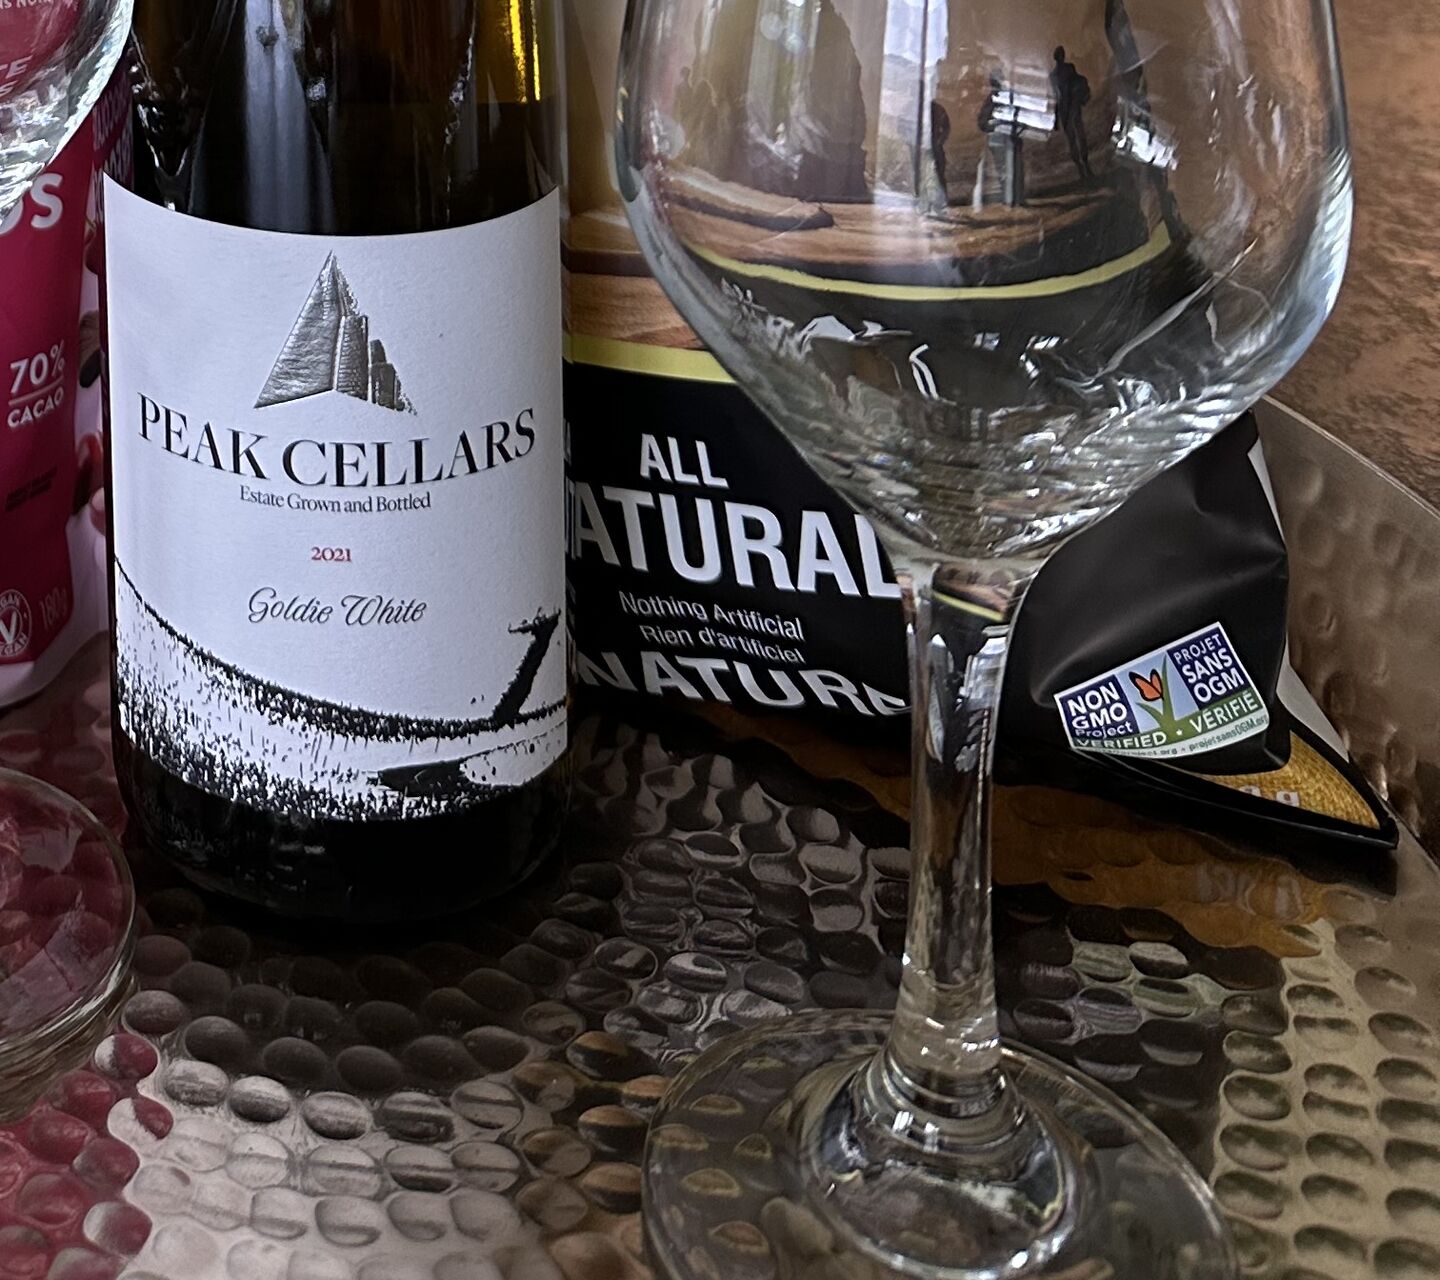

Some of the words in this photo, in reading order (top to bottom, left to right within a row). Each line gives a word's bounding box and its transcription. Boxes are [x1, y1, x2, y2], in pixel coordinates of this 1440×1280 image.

[10, 339, 65, 395] 70%
[6, 385, 65, 430] CACAO
[137, 391, 271, 481] PEAK
[282, 406, 536, 488] CELLARS
[639, 432, 731, 490] ALL
[239, 485, 284, 508] Estate
[287, 492, 341, 513] Grown
[344, 496, 373, 513] and
[376, 491, 432, 513] Bottled
[310, 546, 353, 563] 2021
[572, 480, 903, 599] ATURAL
[248, 586, 334, 624] Goldie
[340, 595, 428, 626] White
[618, 590, 708, 622] Nothing
[713, 604, 806, 641] Artificial
[639, 625, 694, 647] Rien
[698, 624, 807, 664] d'artificiel
[1173, 633, 1222, 665] PROJET
[1181, 647, 1233, 684] SANS
[1067, 681, 1123, 718] NON
[1193, 667, 1245, 703] OGM
[1071, 702, 1129, 731] GMO
[1075, 723, 1134, 739] Project
[1076, 731, 1168, 750] VERIFIED
